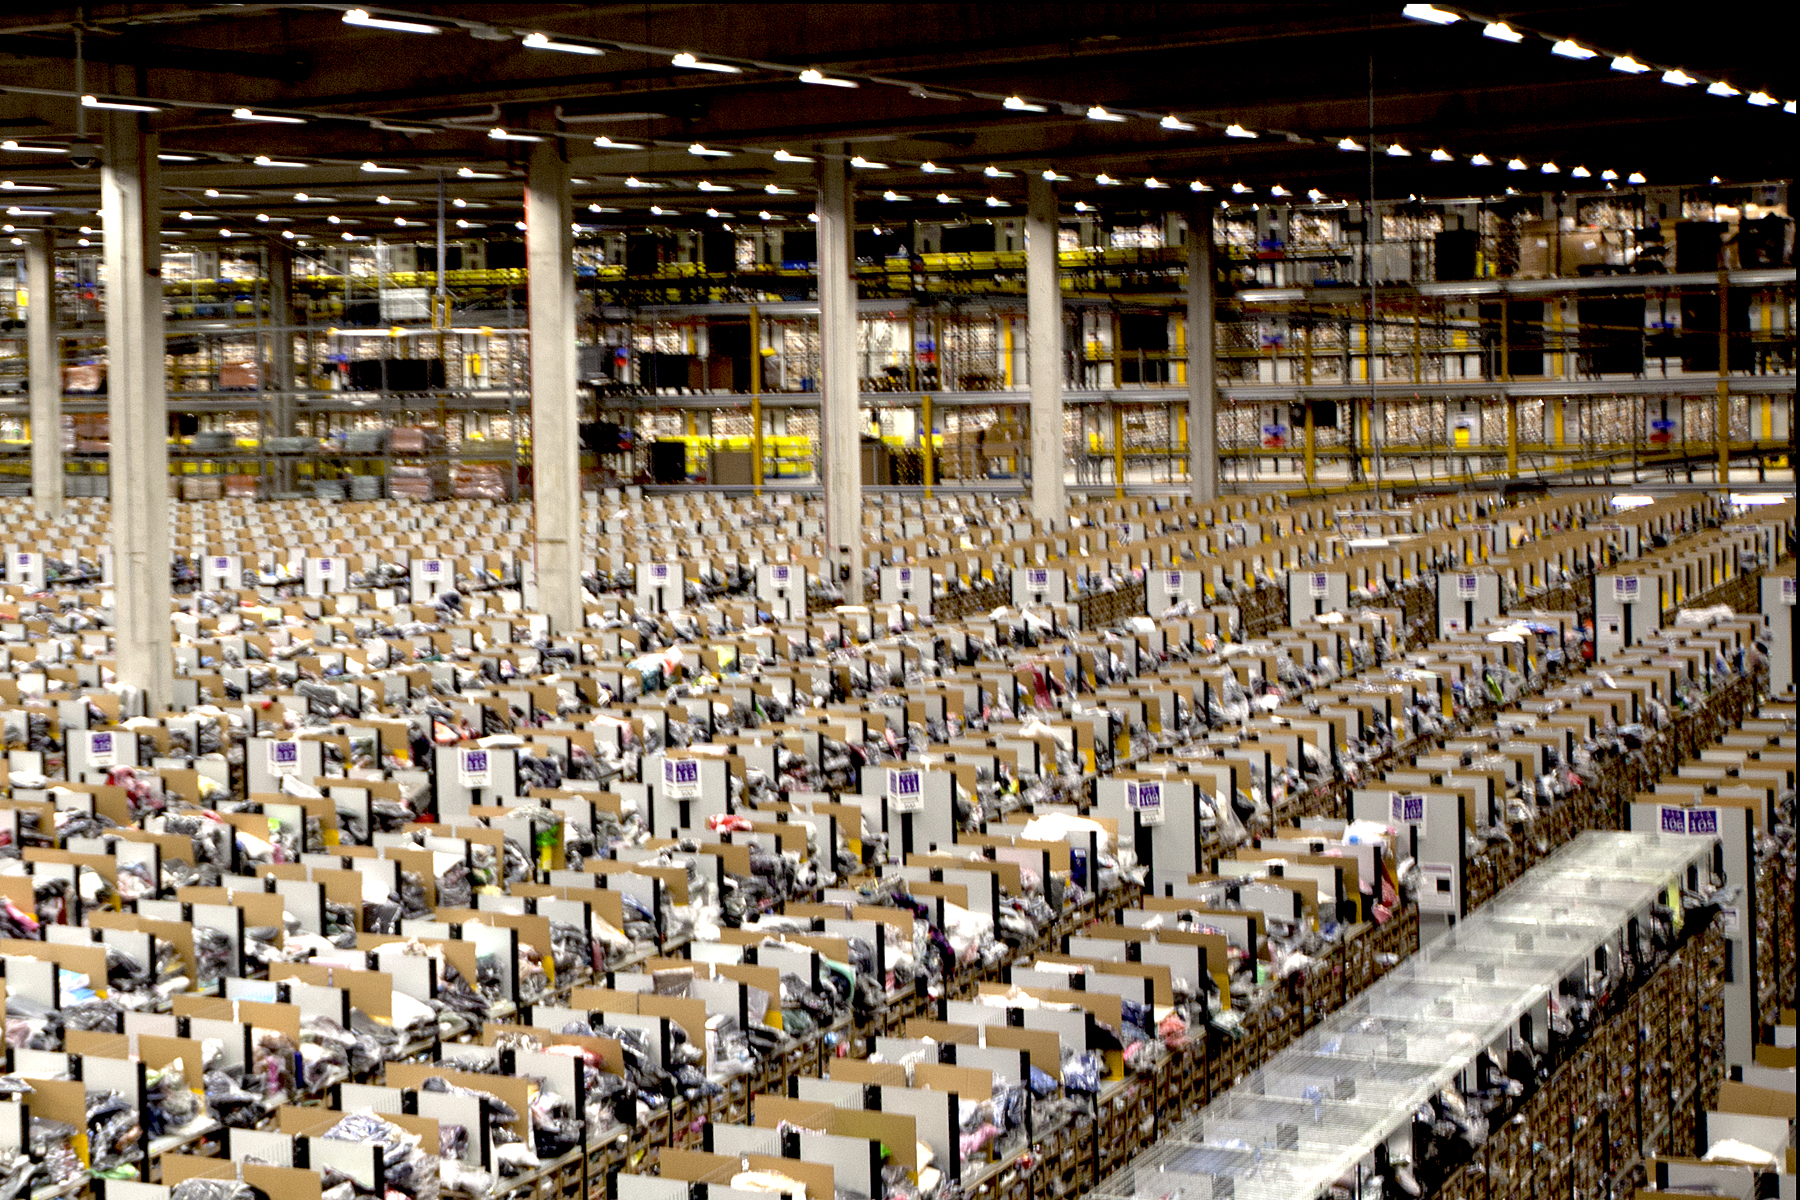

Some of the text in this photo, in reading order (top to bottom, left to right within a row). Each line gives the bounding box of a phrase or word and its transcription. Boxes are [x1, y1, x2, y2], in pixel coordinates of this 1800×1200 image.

[468, 760, 486, 770] 115
[677, 770, 697, 781] 113
[900, 781, 918, 793] 111
[1140, 793, 1159, 806] 109
[1691, 818, 1715, 832] 105
